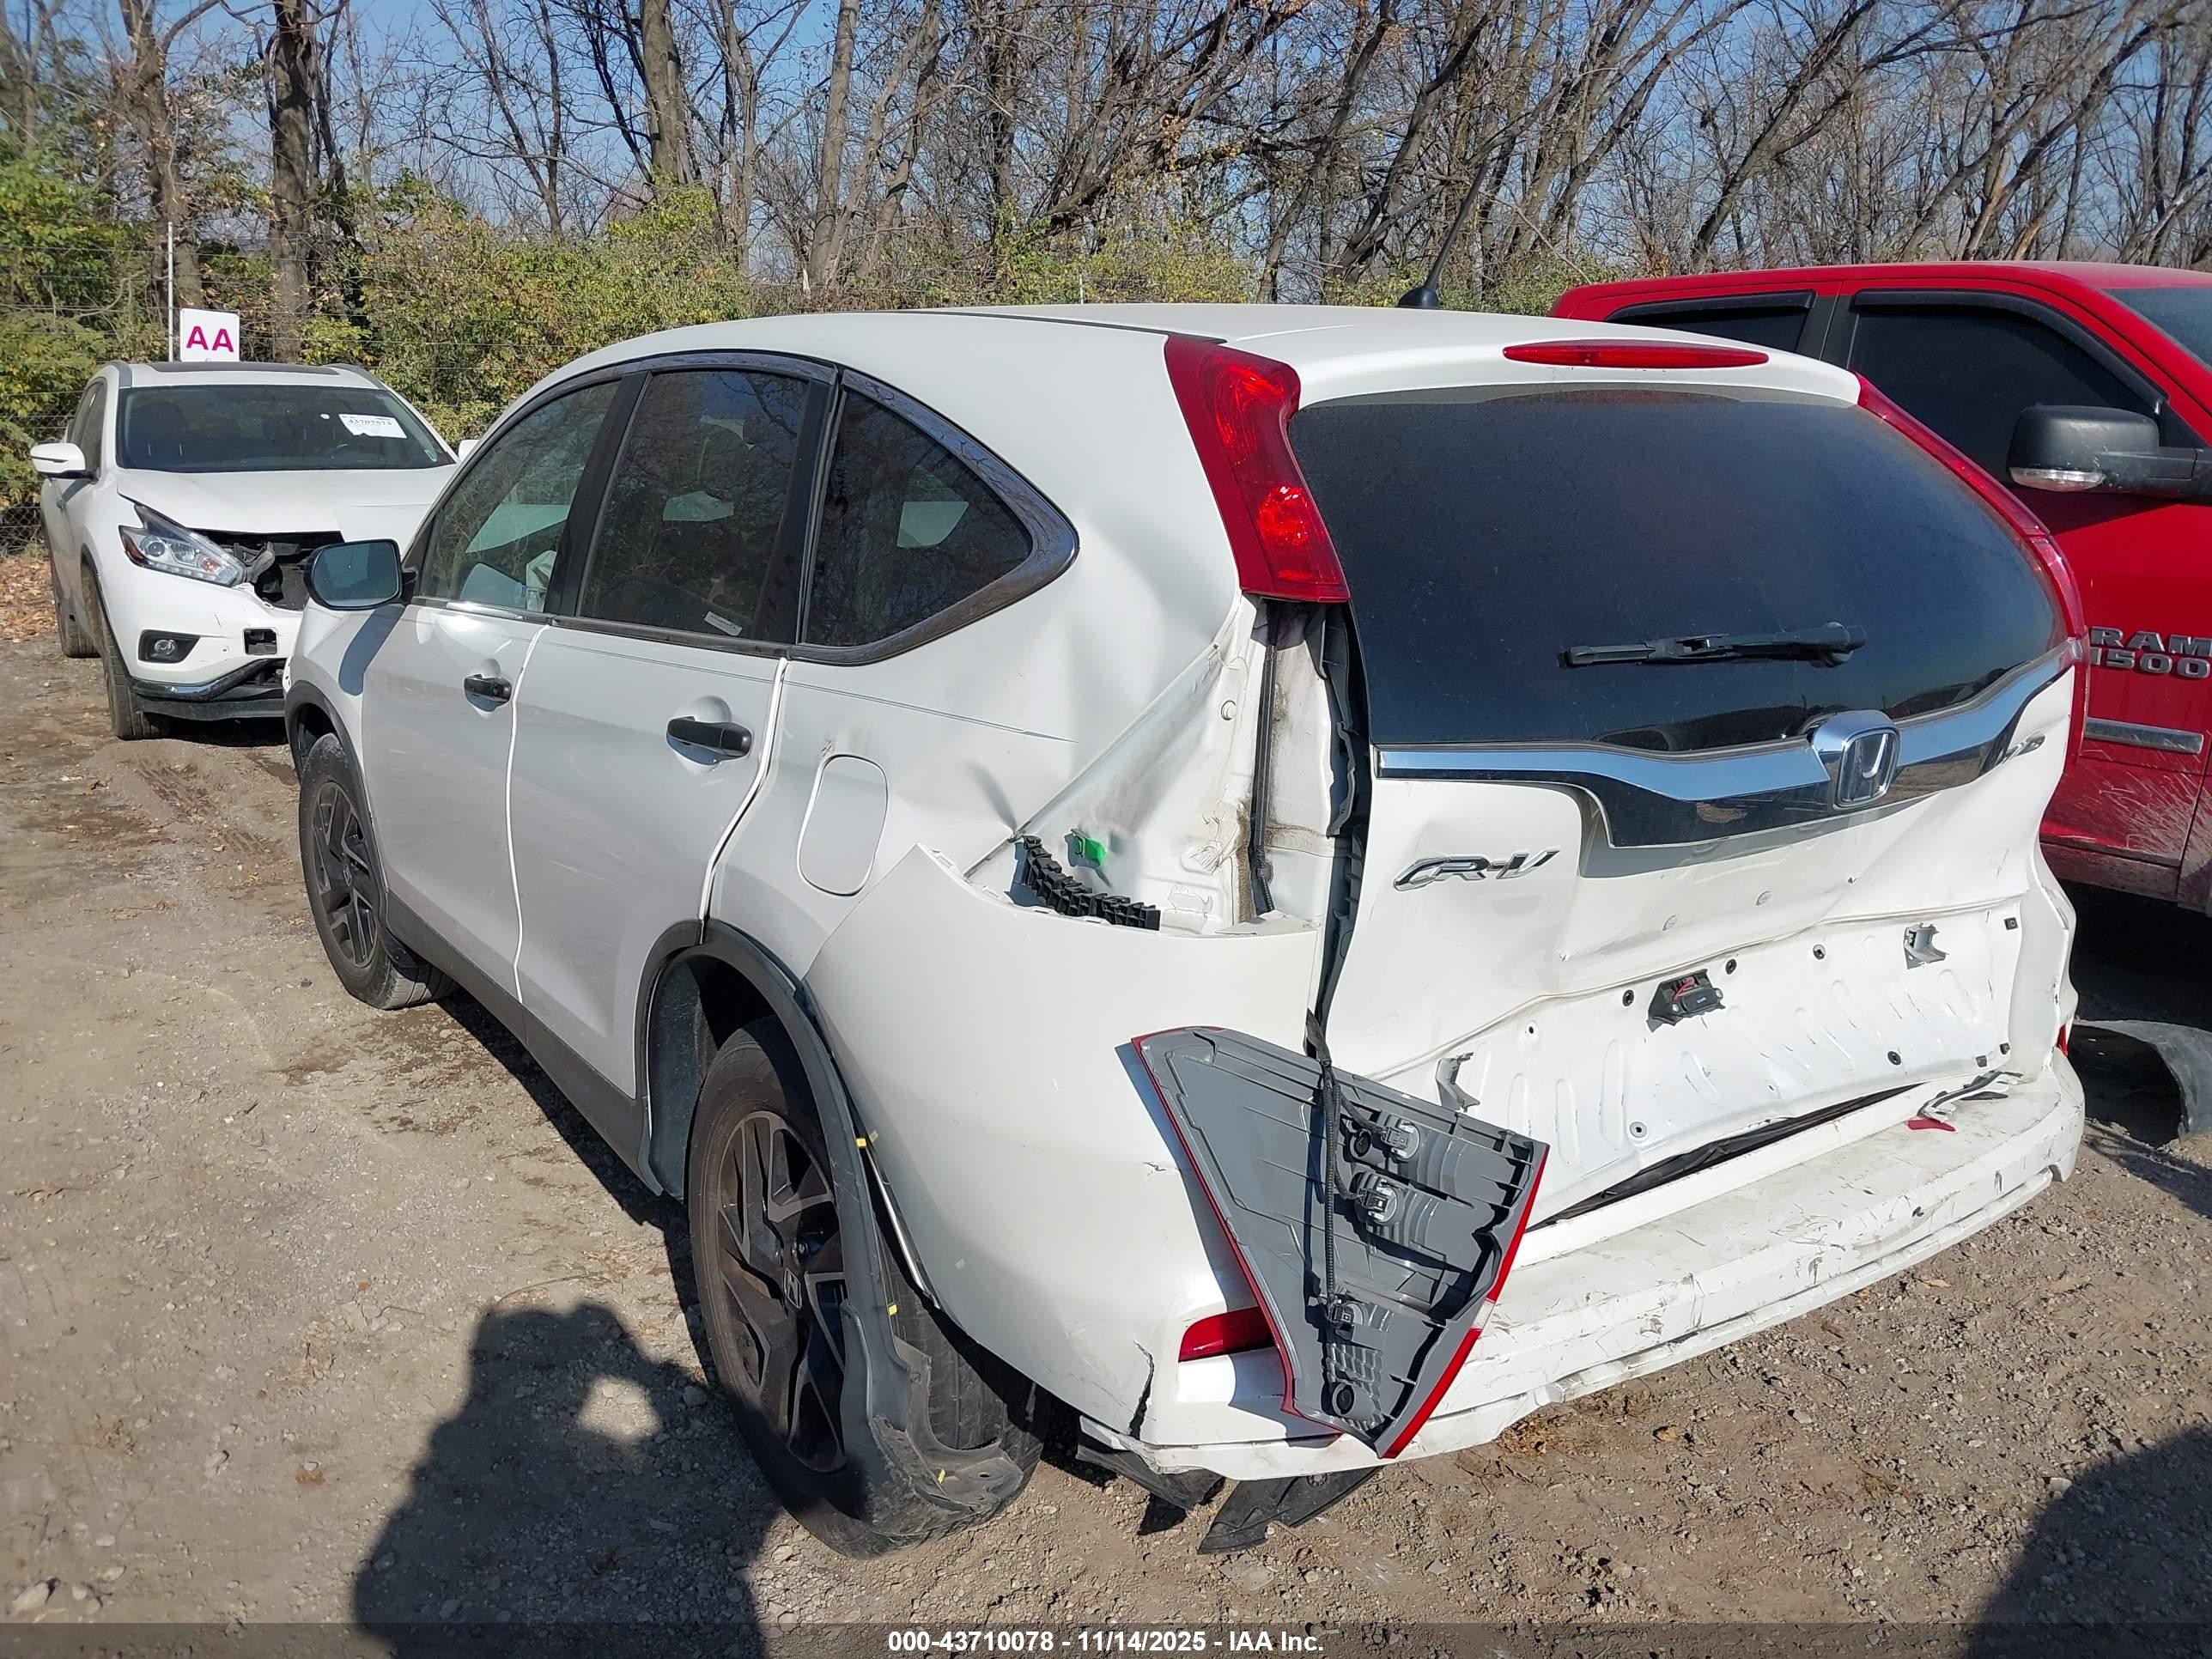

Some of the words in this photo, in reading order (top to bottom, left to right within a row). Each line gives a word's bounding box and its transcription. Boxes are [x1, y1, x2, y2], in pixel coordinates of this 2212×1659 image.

[185, 325, 234, 353] AA
[2090, 626, 2212, 658] RAM
[2090, 646, 2211, 679] 1500
[1393, 849, 1561, 891] CR-V
